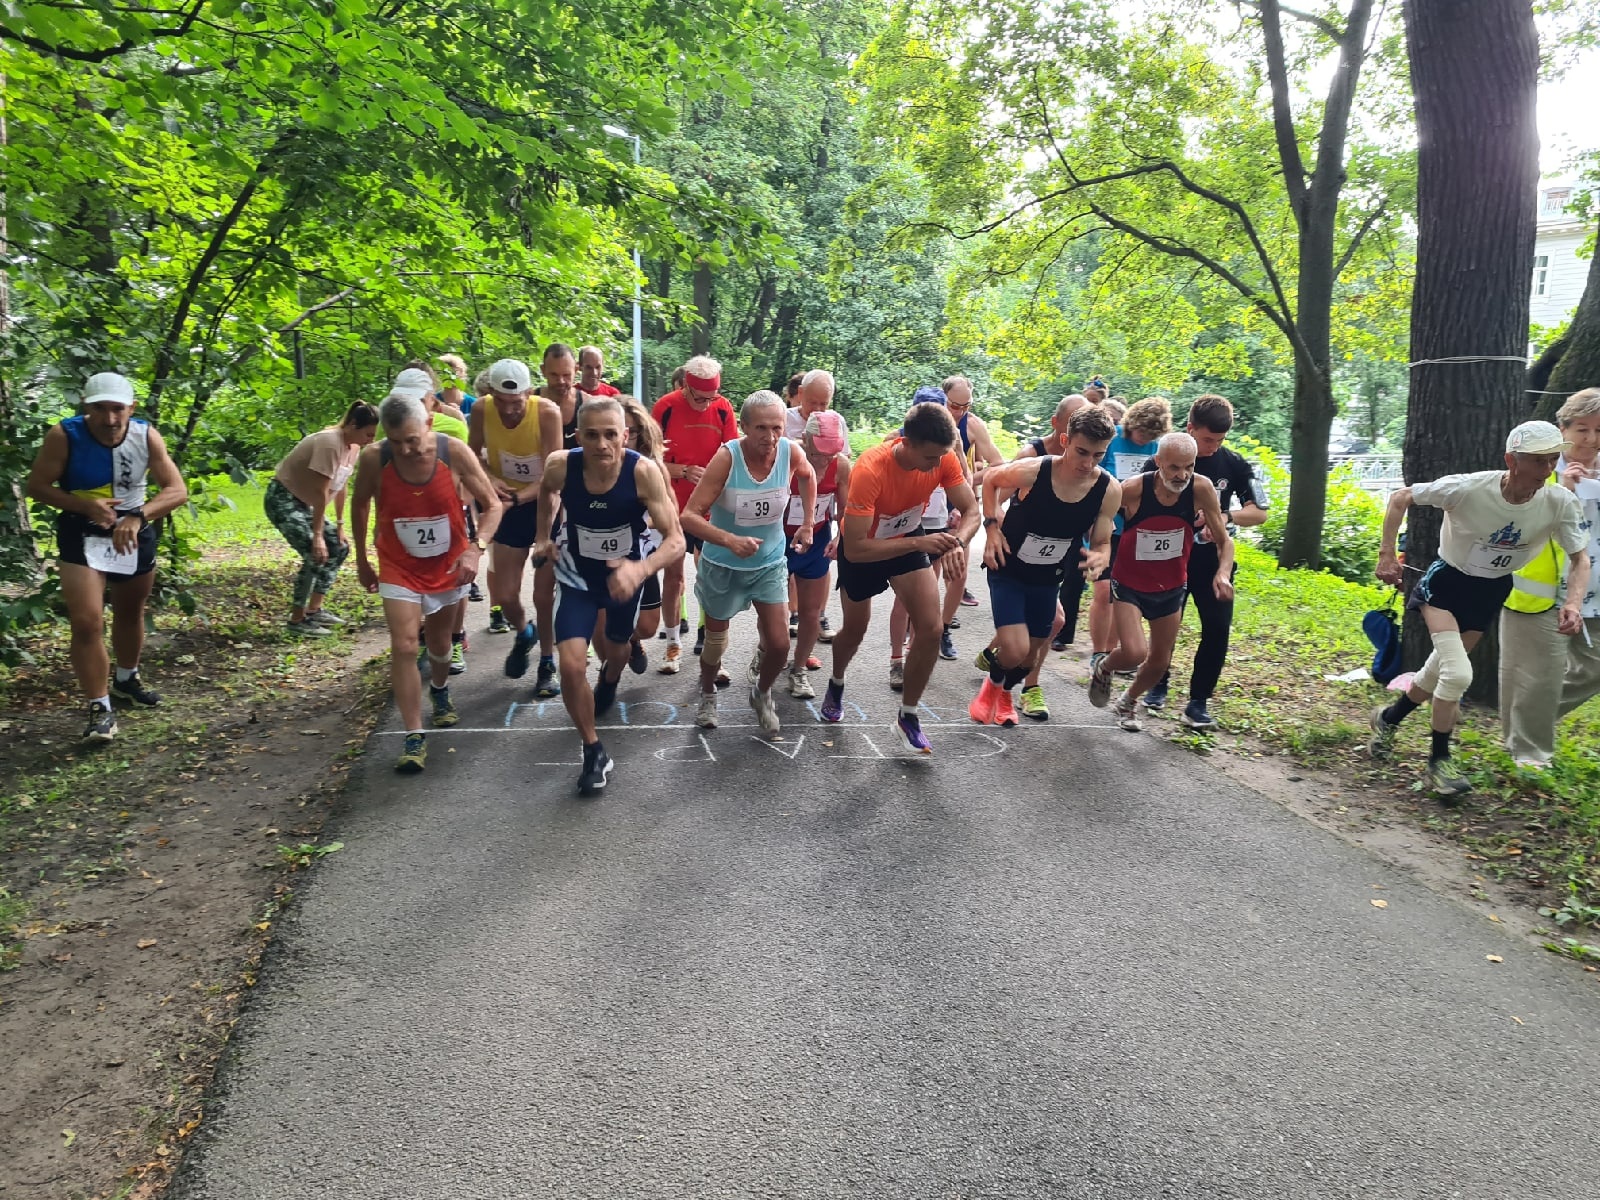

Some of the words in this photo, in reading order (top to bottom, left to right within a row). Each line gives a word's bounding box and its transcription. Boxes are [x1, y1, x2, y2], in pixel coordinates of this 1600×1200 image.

[514, 463, 530, 475] 33
[754, 501, 770, 517] 39
[417, 528, 436, 545] 24
[601, 539, 618, 552] 49
[1038, 544, 1056, 557] 42
[1154, 539, 1170, 551] 26
[1490, 555, 1512, 568] 40
